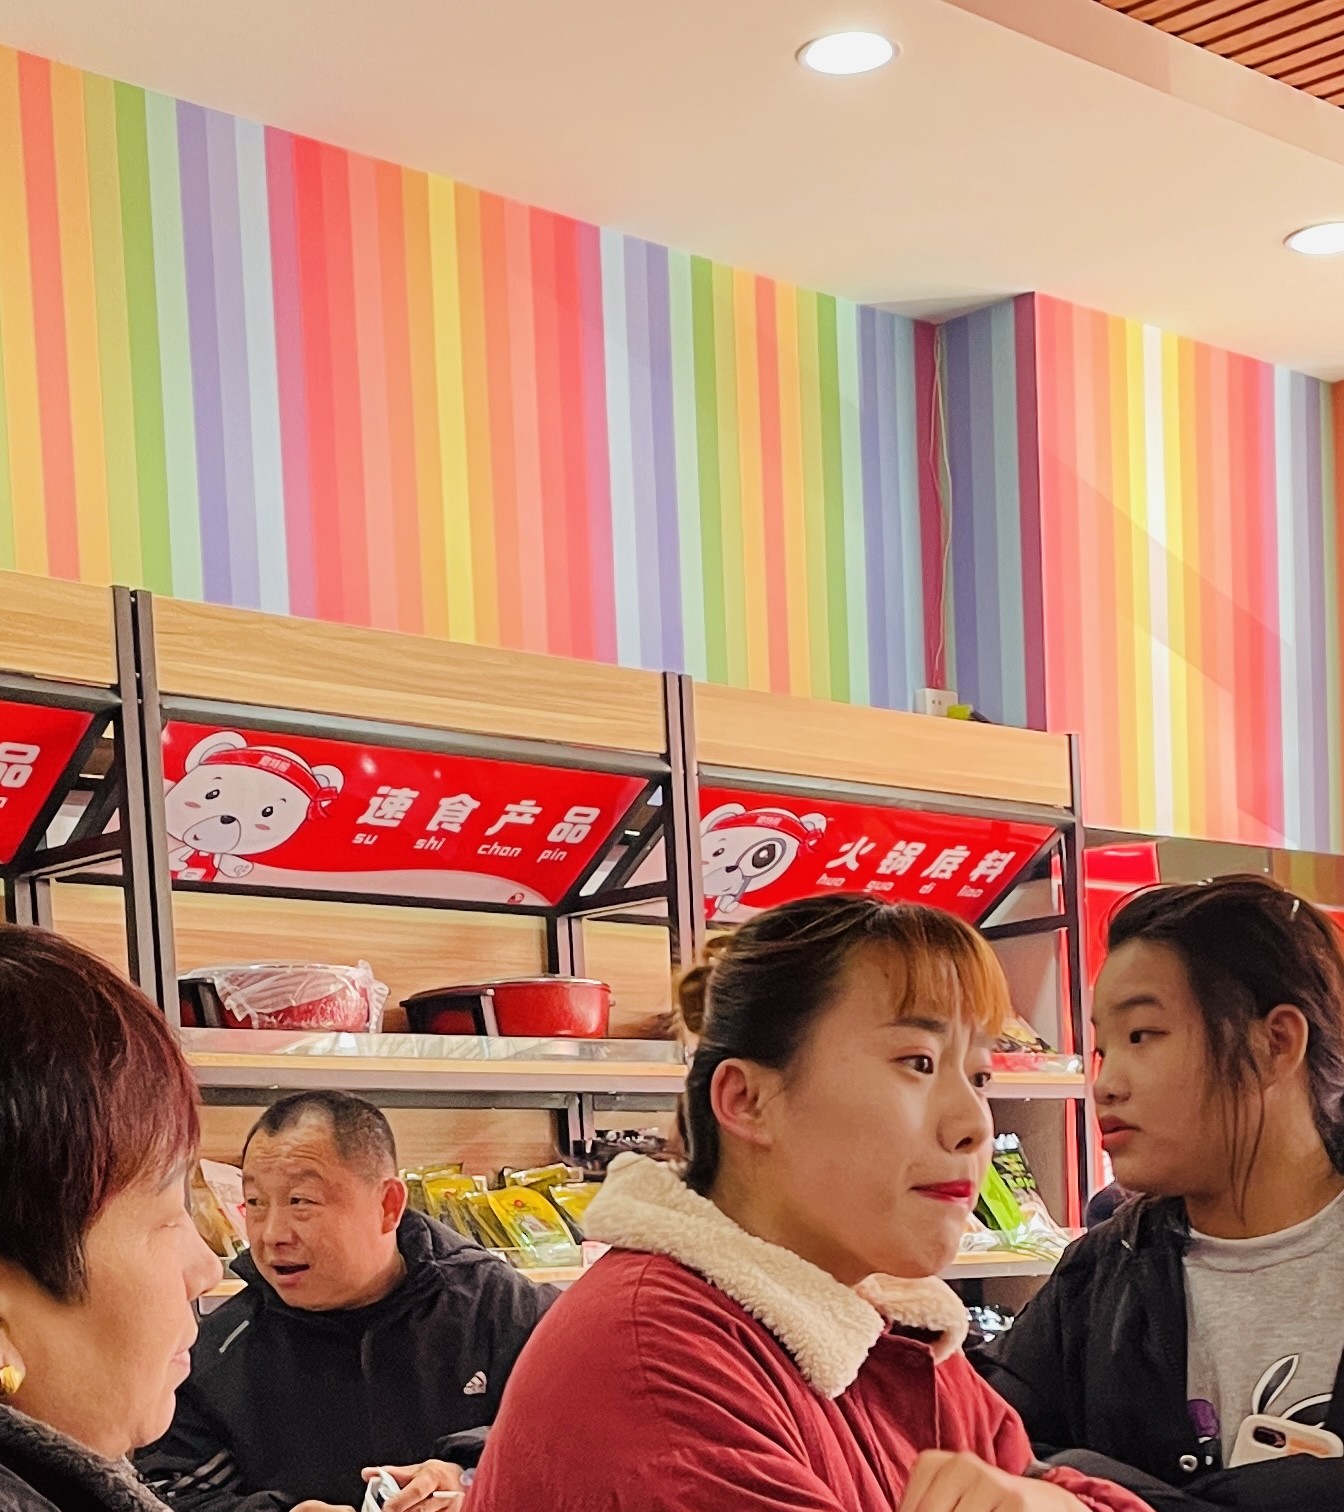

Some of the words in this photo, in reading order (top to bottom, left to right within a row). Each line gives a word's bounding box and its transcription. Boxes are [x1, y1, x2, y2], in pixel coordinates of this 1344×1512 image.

[365, 785, 601, 845] 速食产品
[352, 833, 378, 845] su
[413, 836, 446, 851] shi
[477, 841, 522, 858] chan
[537, 848, 567, 862] pin
[825, 836, 1016, 882] 火锅底料
